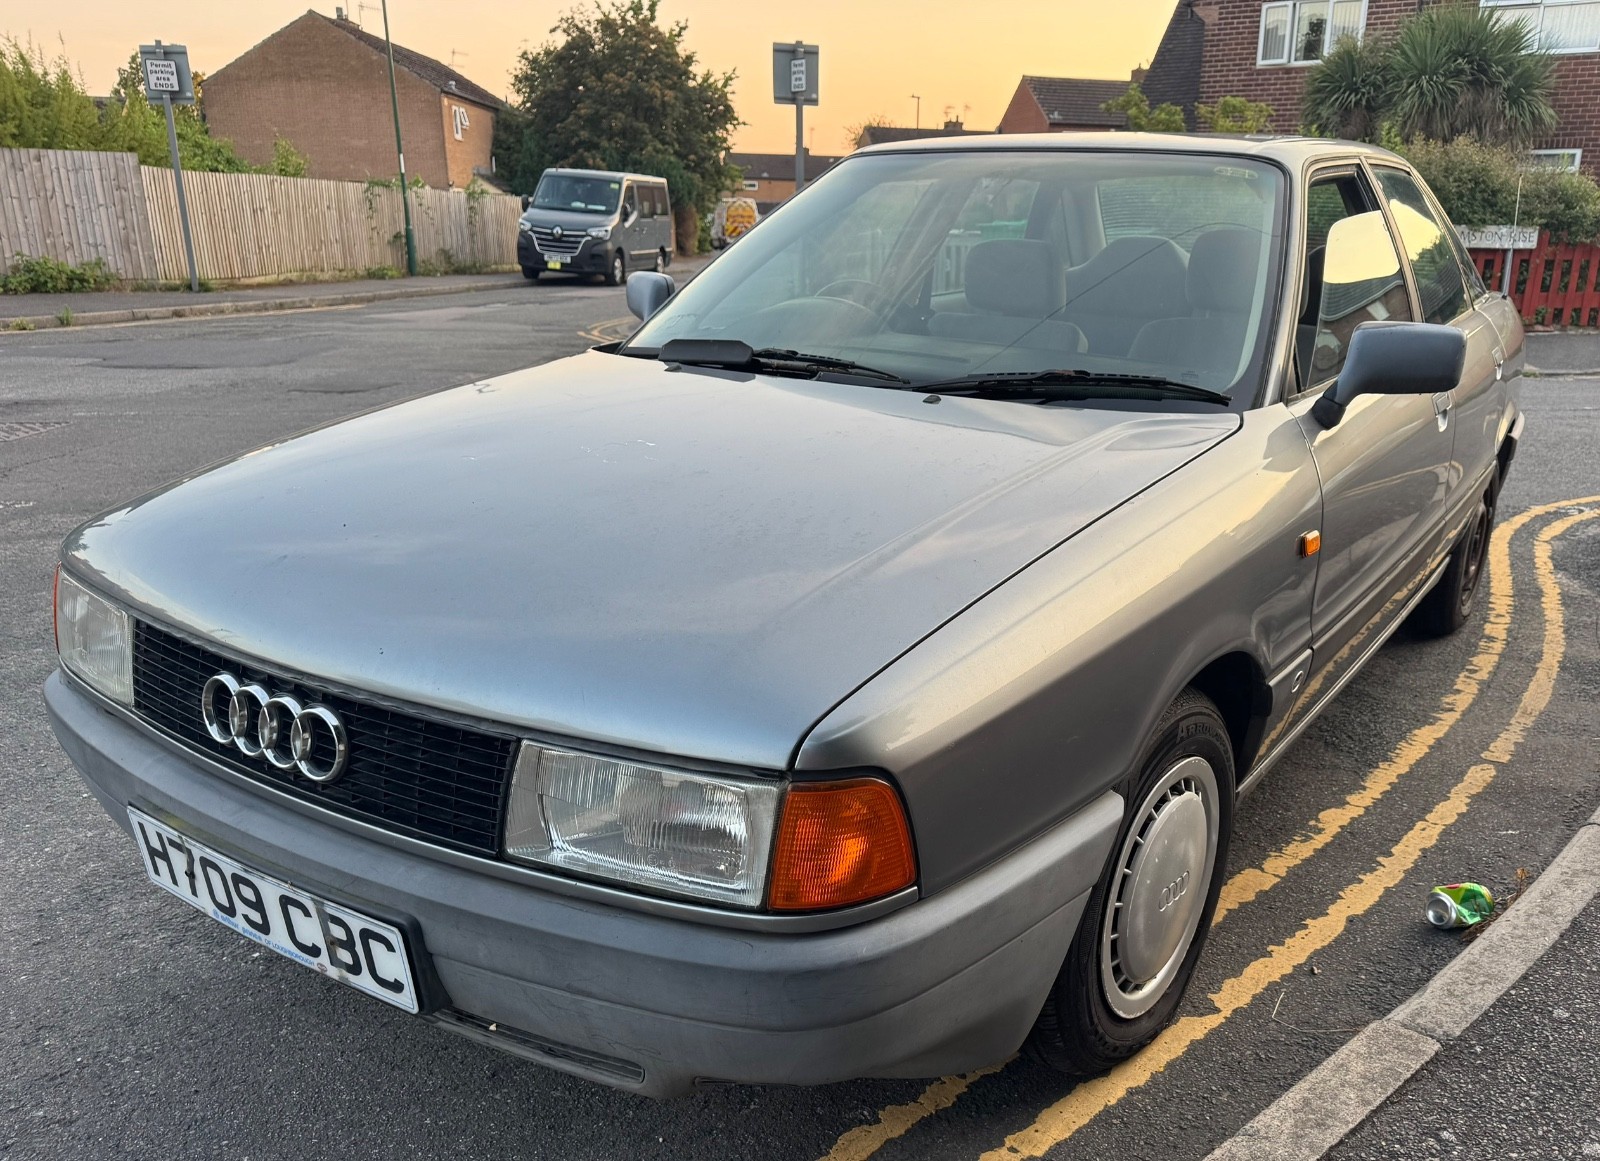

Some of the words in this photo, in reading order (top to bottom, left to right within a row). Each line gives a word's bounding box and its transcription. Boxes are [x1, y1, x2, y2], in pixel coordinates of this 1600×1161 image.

[1509, 231, 1534, 243] RISE
[137, 821, 271, 936] H709
[279, 894, 405, 994] CBC
